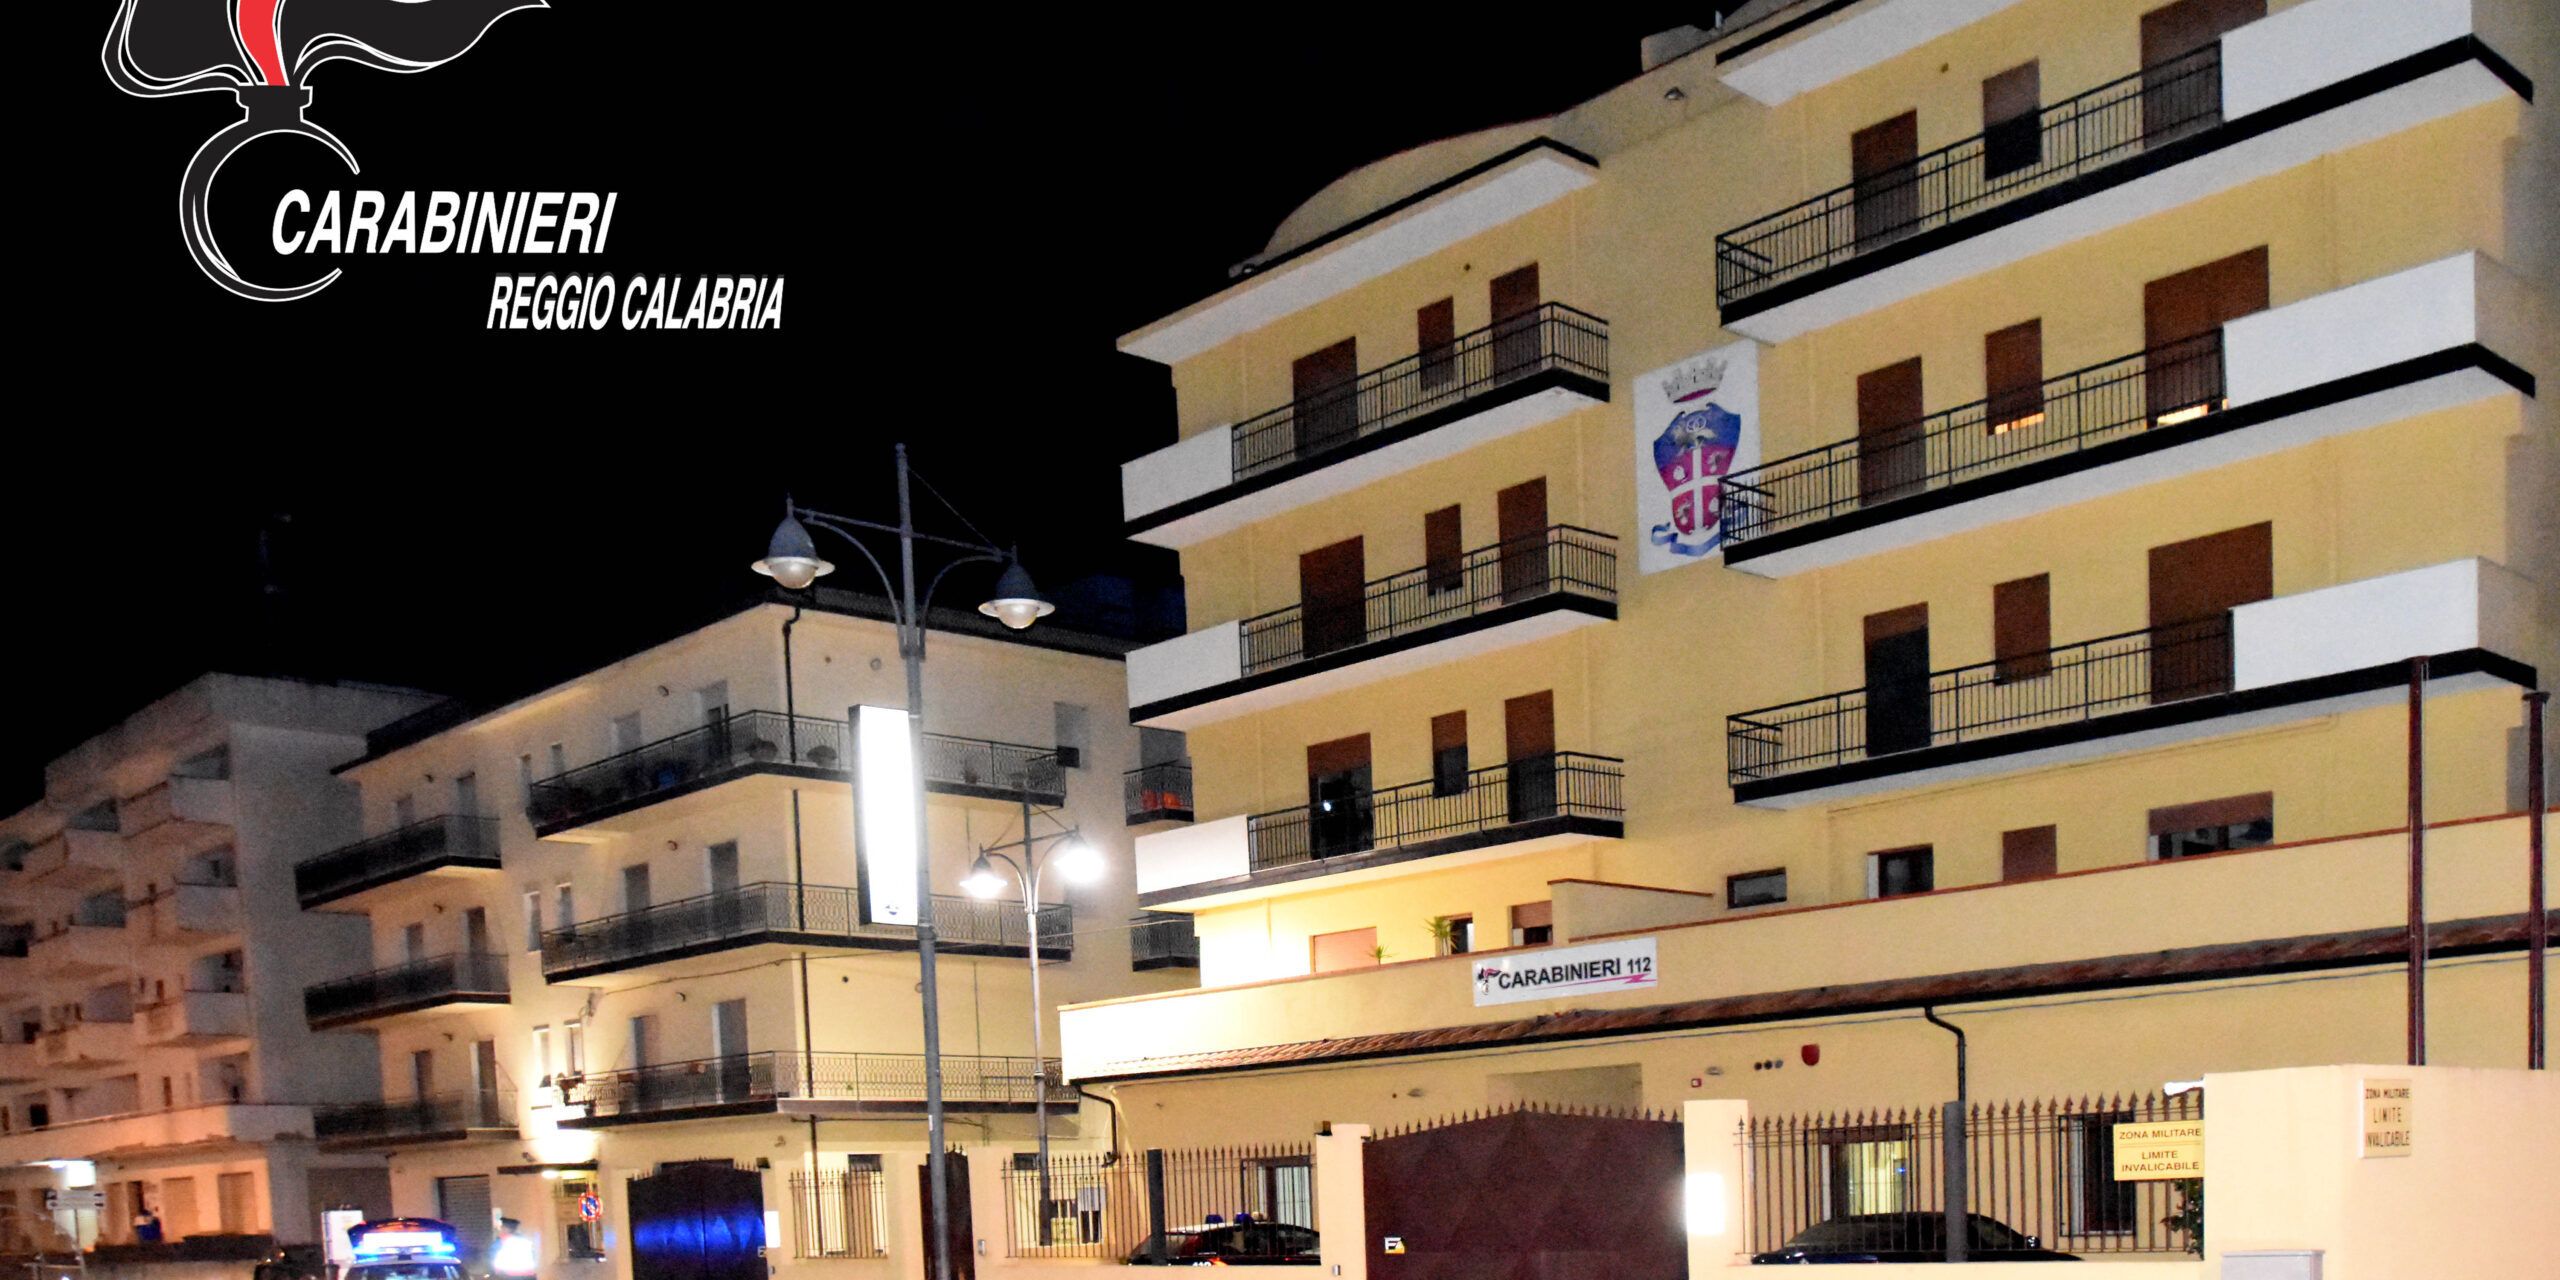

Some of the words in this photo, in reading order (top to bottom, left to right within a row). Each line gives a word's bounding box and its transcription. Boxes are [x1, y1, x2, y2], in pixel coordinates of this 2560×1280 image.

[1499, 957, 1621, 990] CARABINIERI
[1626, 957, 1652, 974] 112
[2373, 1107, 2402, 1124] LIMITE
[2119, 1130, 2149, 1140] ZONA
[2152, 1127, 2202, 1138] MILITARE
[2141, 1150, 2179, 1160] LIMITE
[2121, 1161, 2200, 1172] INVALICABILE
